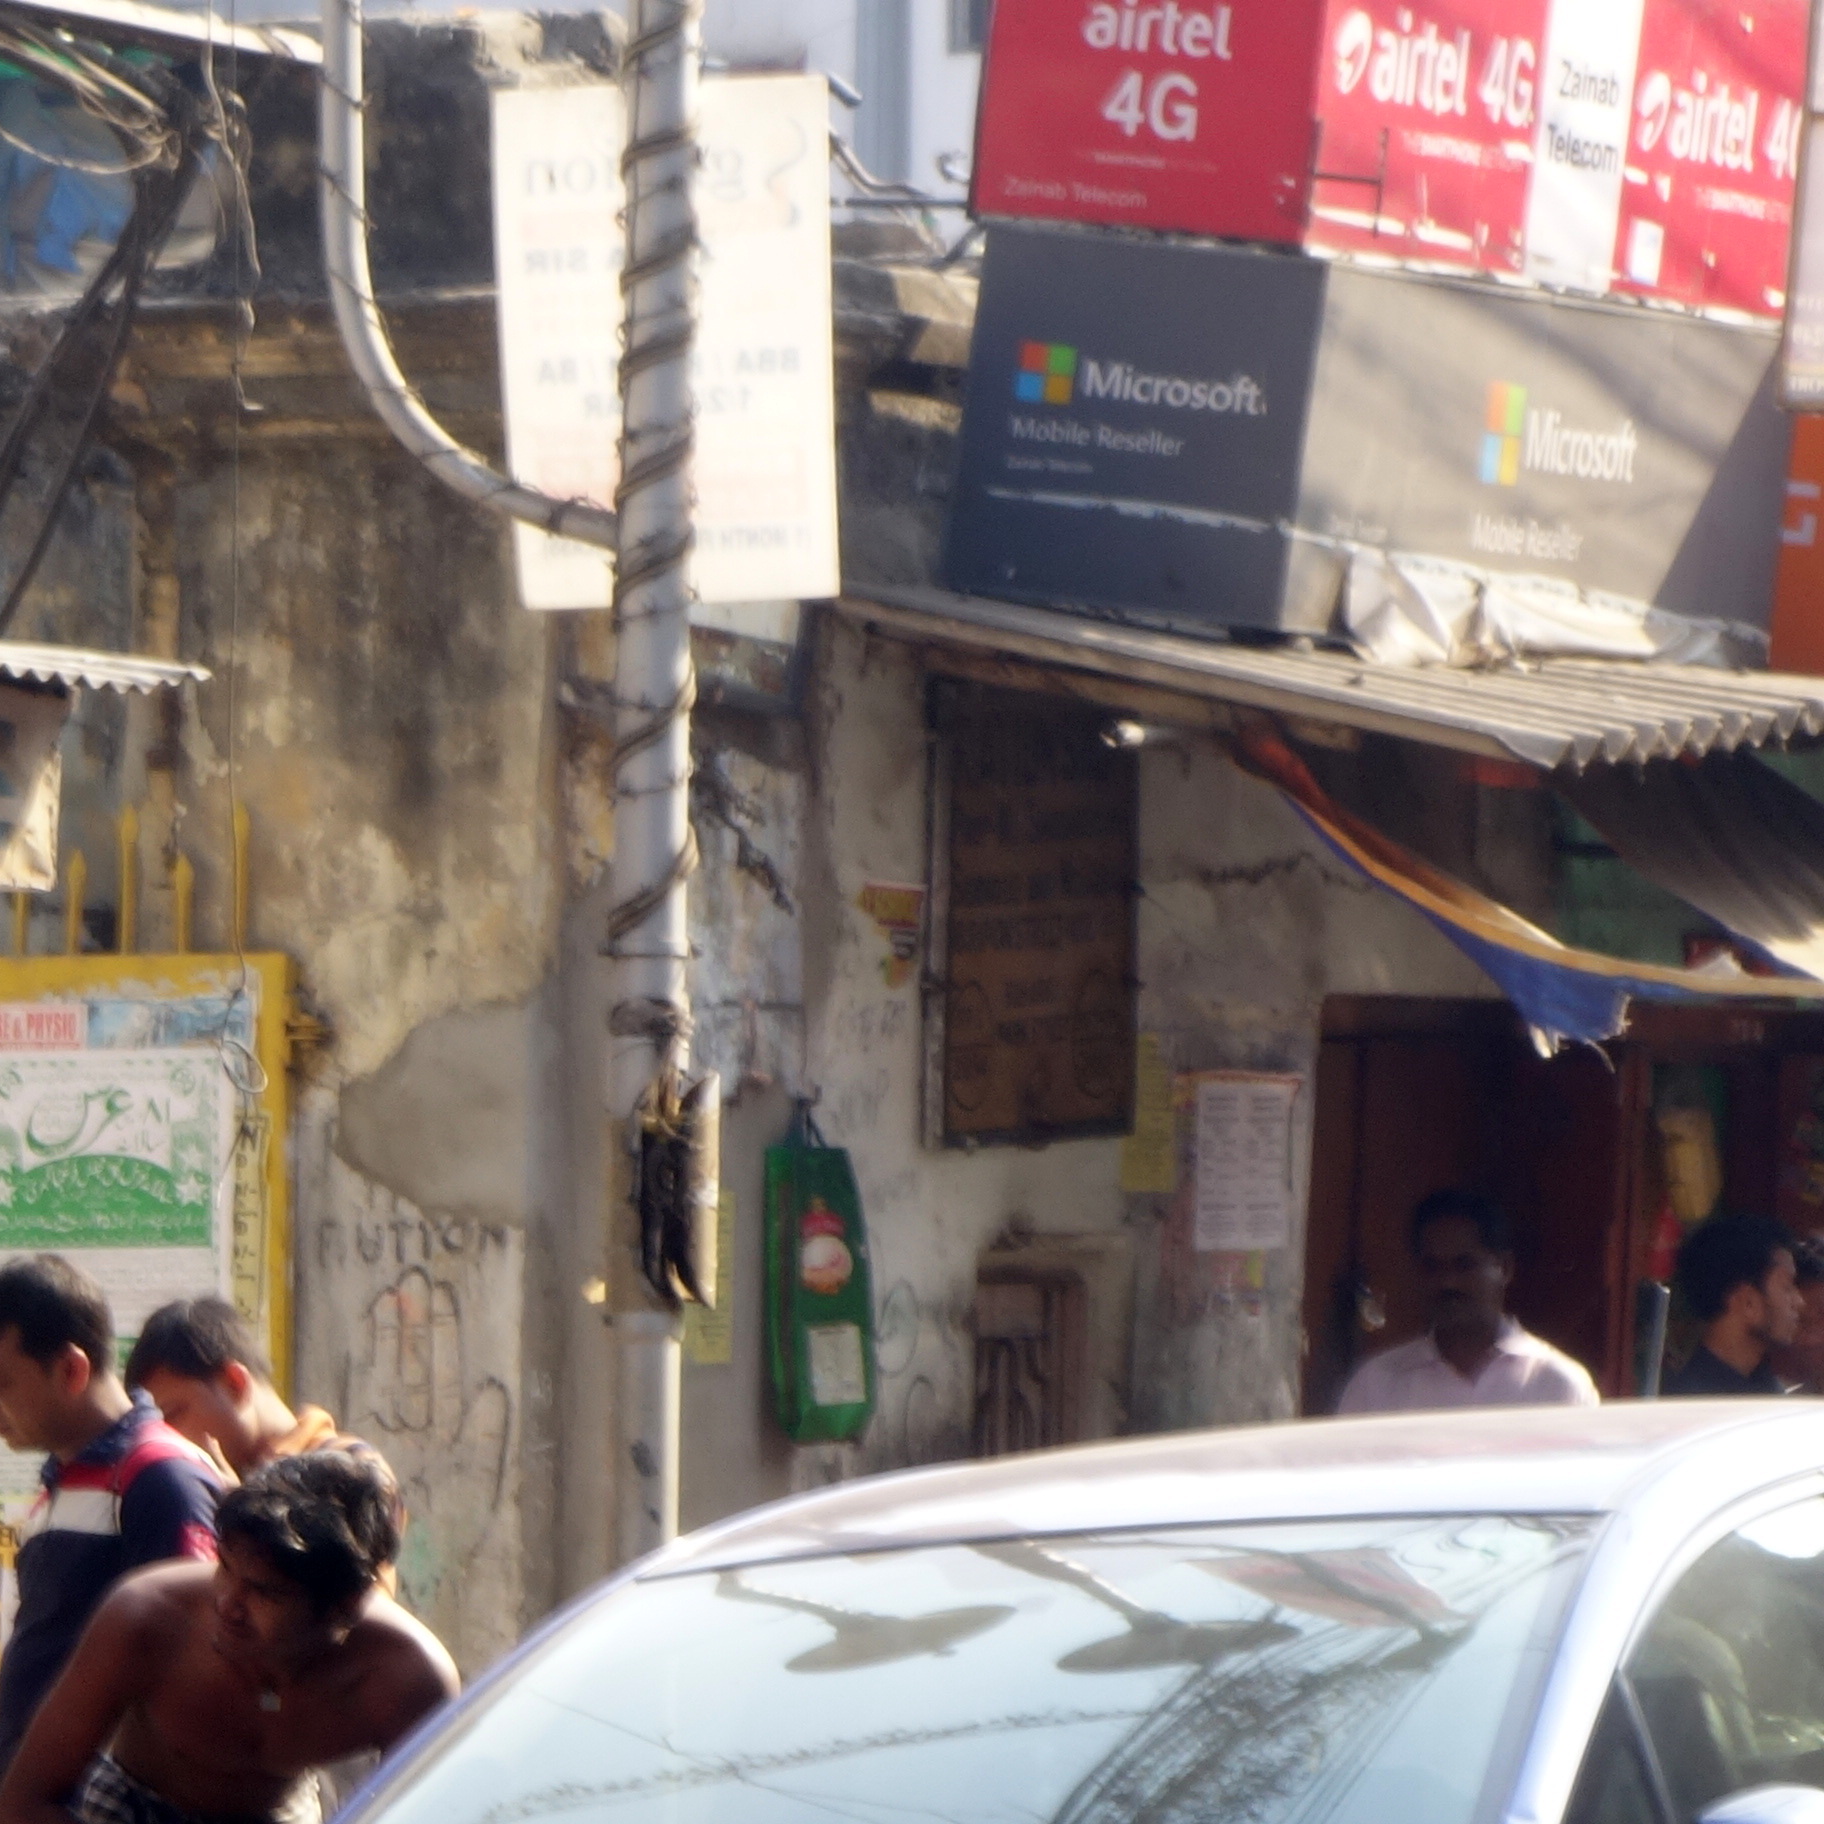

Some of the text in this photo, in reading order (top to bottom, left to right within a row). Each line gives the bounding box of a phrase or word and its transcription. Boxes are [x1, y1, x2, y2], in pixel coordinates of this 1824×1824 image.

[1083, 0, 1232, 61] airtel
[1368, 7, 1537, 128] airtel 4G
[1558, 59, 1620, 107] Zainab
[1102, 69, 1199, 142] 4G
[1666, 70, 1759, 172] airtel
[1548, 123, 1619, 173] Telecom
[1081, 357, 1264, 416] Microsoft
[1010, 416, 1185, 457] Mobile Reseller
[1524, 407, 1637, 484] Microsoft
